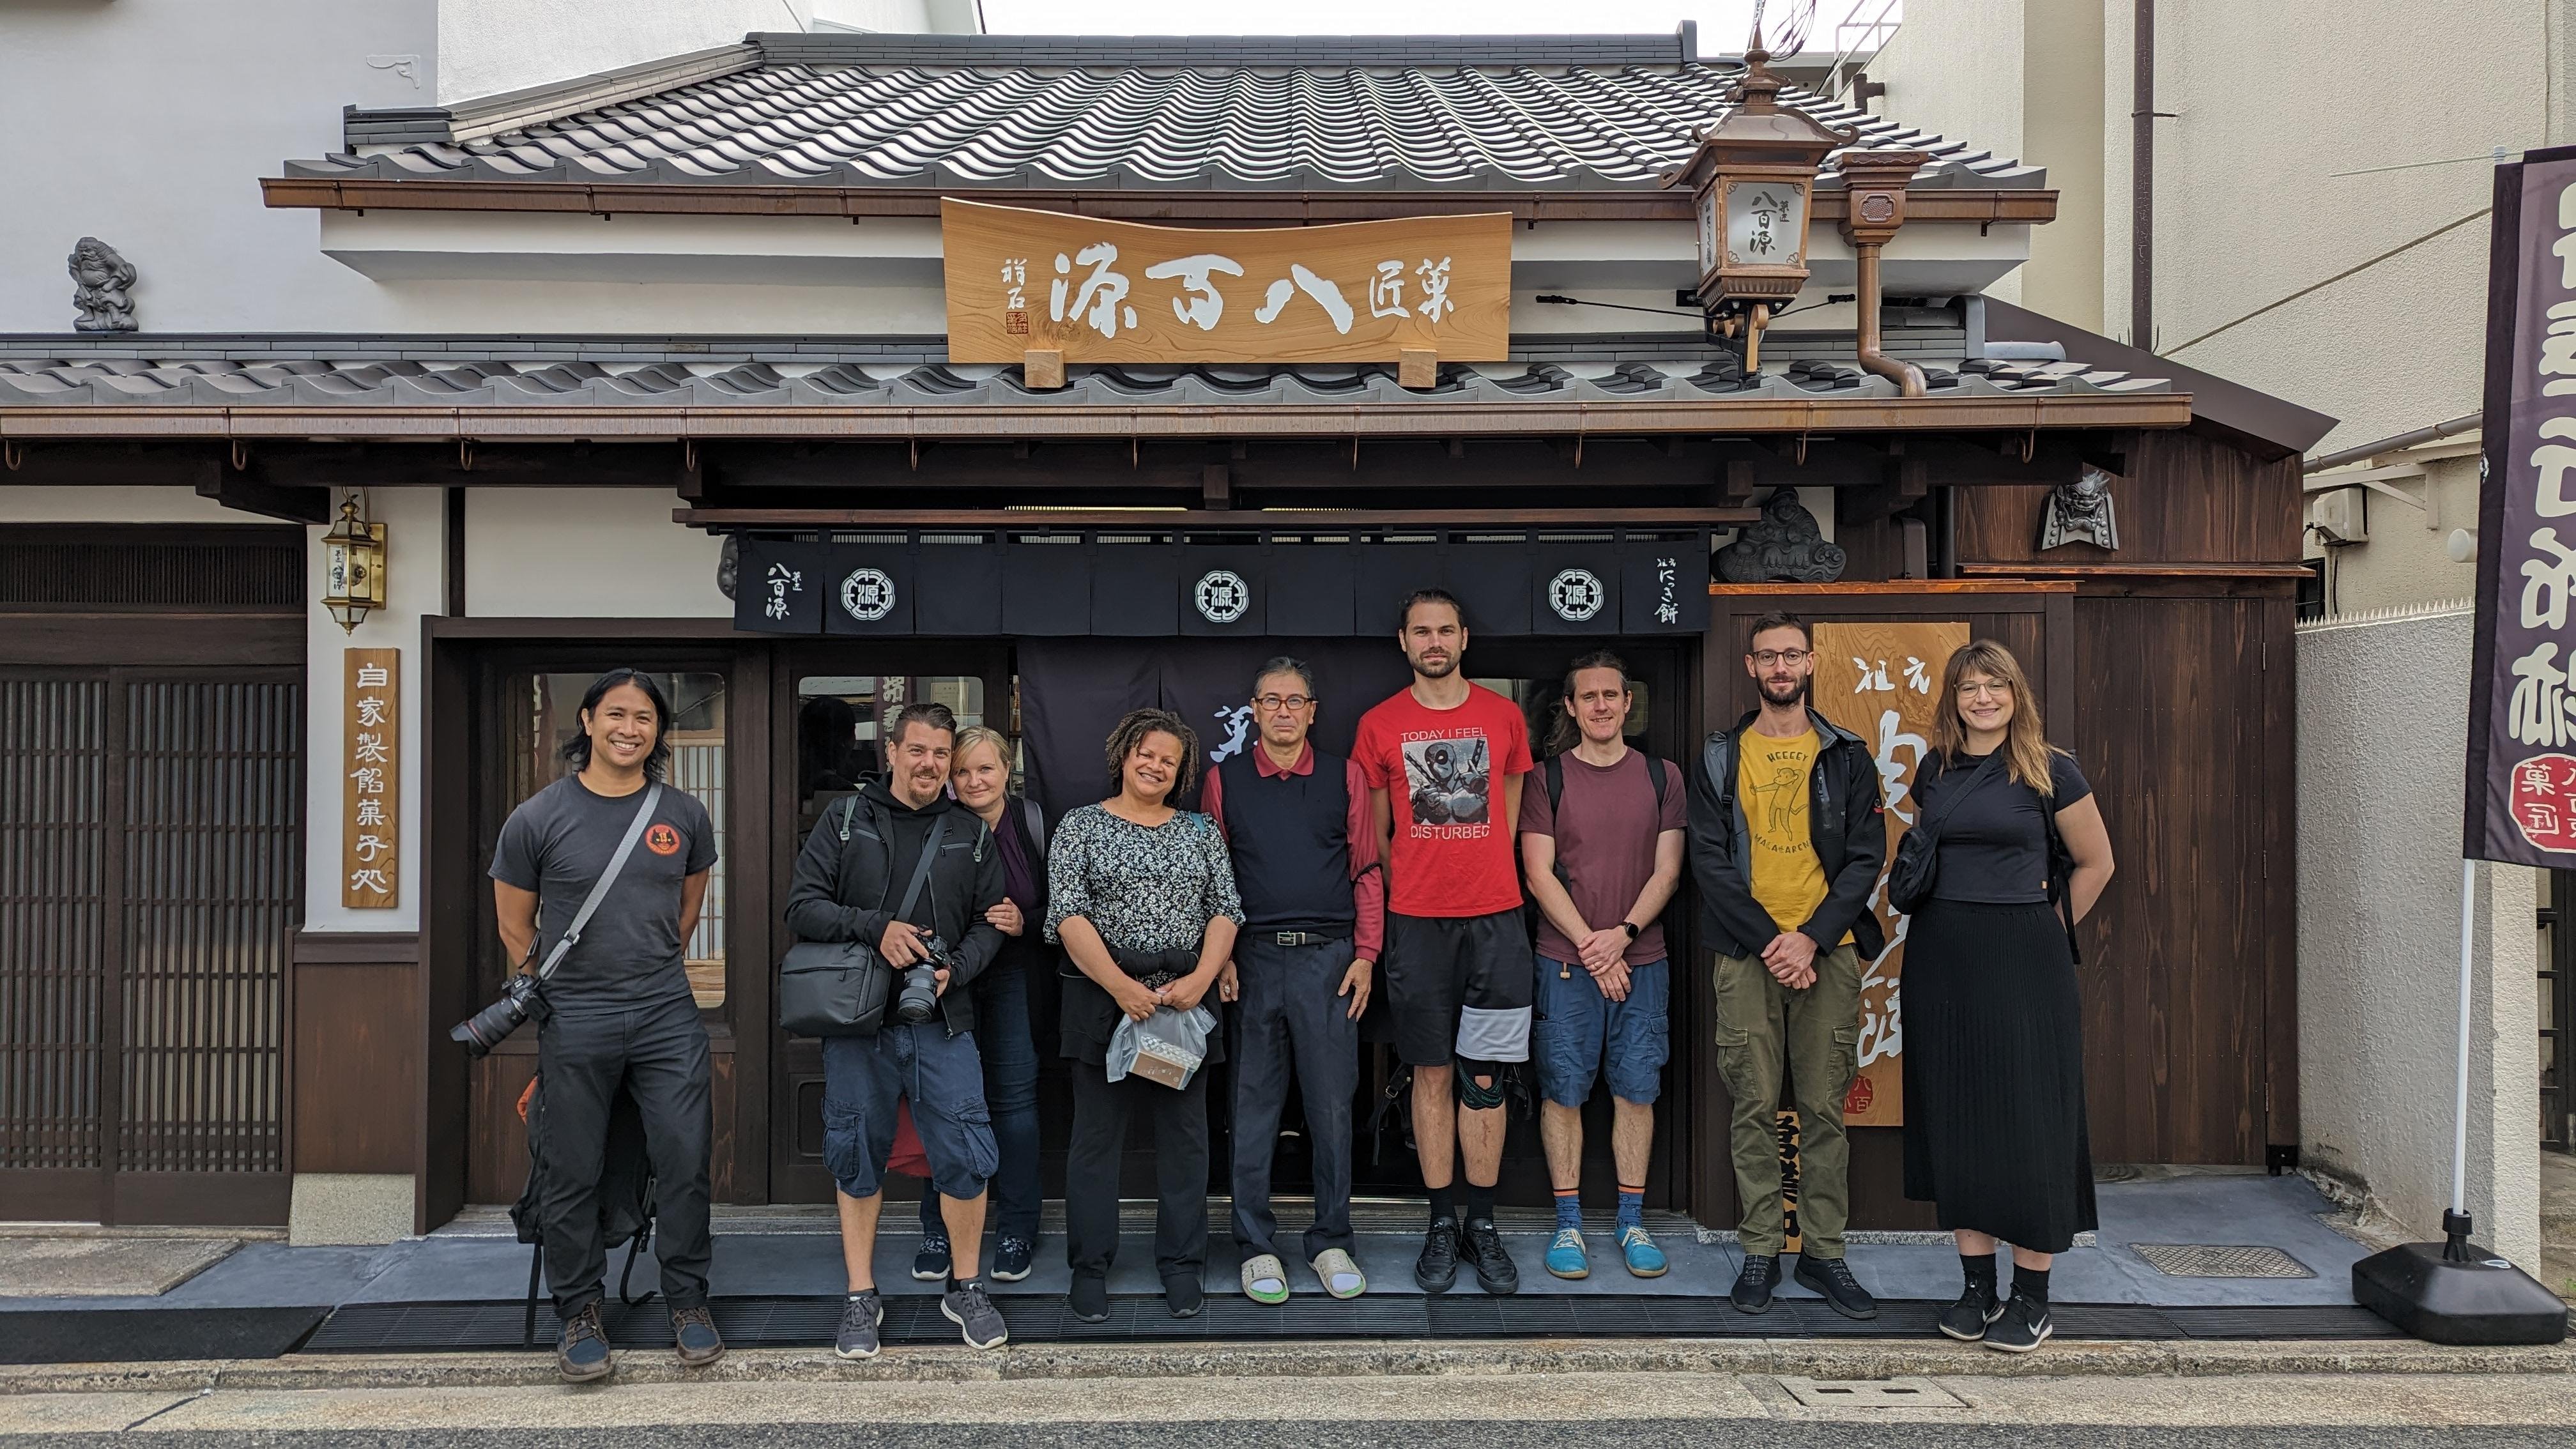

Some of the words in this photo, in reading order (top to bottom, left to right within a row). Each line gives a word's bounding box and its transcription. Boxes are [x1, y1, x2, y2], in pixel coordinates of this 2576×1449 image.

[1750, 191, 1778, 255] 八百源
[766, 563, 791, 620] 八百源
[1400, 730, 1445, 742] TODAY
[1455, 727, 1487, 737] FEEL
[1411, 825, 1490, 839] DISTURBED
